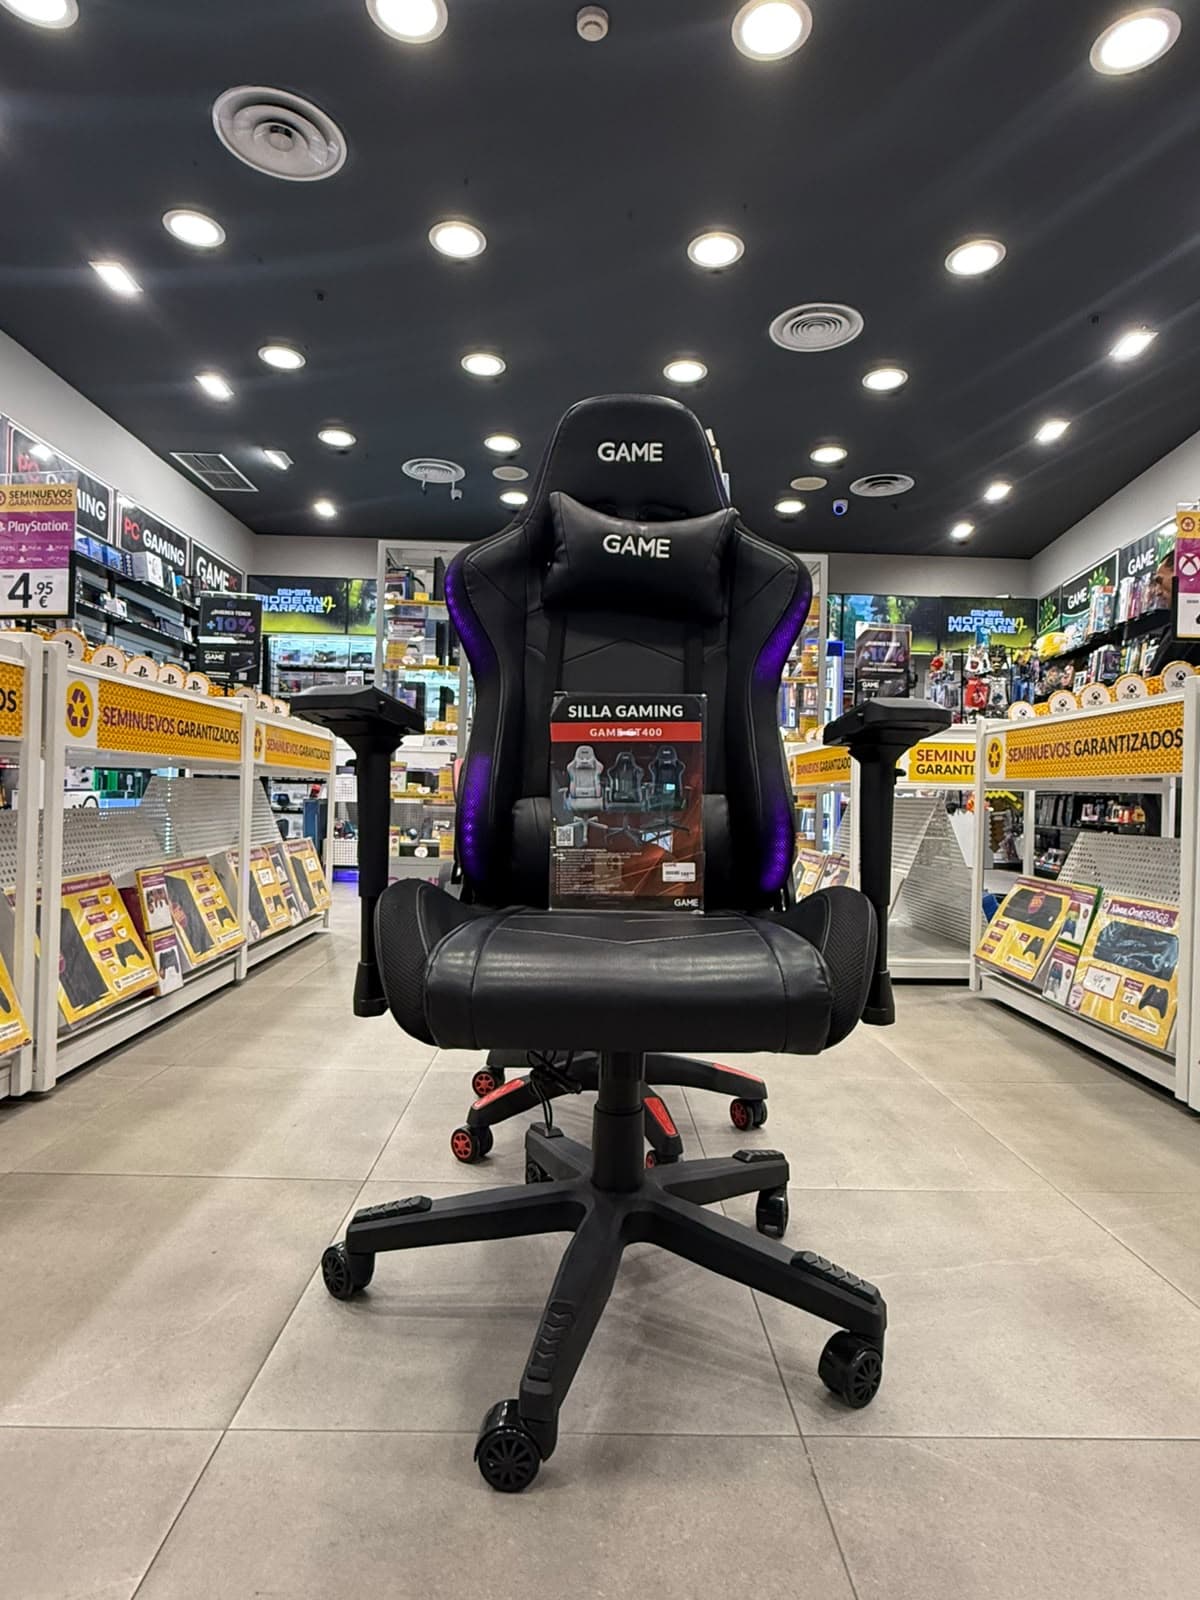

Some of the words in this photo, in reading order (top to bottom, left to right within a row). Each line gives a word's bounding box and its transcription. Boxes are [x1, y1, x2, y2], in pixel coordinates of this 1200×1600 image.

[598, 442, 663, 462] GAME
[8, 498, 72, 506] GARANTIZADOS
[9, 489, 73, 499] SEMINUEVOS
[8, 520, 69, 536] PlayStation
[124, 516, 140, 541] PC
[143, 529, 185, 567] GAMING
[602, 534, 671, 558] GAME
[1128, 548, 1155, 575] GAME
[196, 556, 230, 593] GAME
[8, 572, 33, 608] 4
[1067, 587, 1088, 610] GAME
[948, 616, 1016, 626] MODERN
[948, 624, 1017, 634] WARARE
[568, 705, 611, 718] SILLA
[615, 705, 684, 718] GAMING
[102, 706, 176, 735] SEMINUEVOS
[177, 719, 240, 745] GARANTIZADOS
[1008, 741, 1071, 763] SEMINUEVOS
[1073, 727, 1184, 757] GARANTIZADOS
[916, 749, 976, 762] SEMINU
[916, 763, 977, 775] GARANTI
[673, 898, 699, 907] GAME
